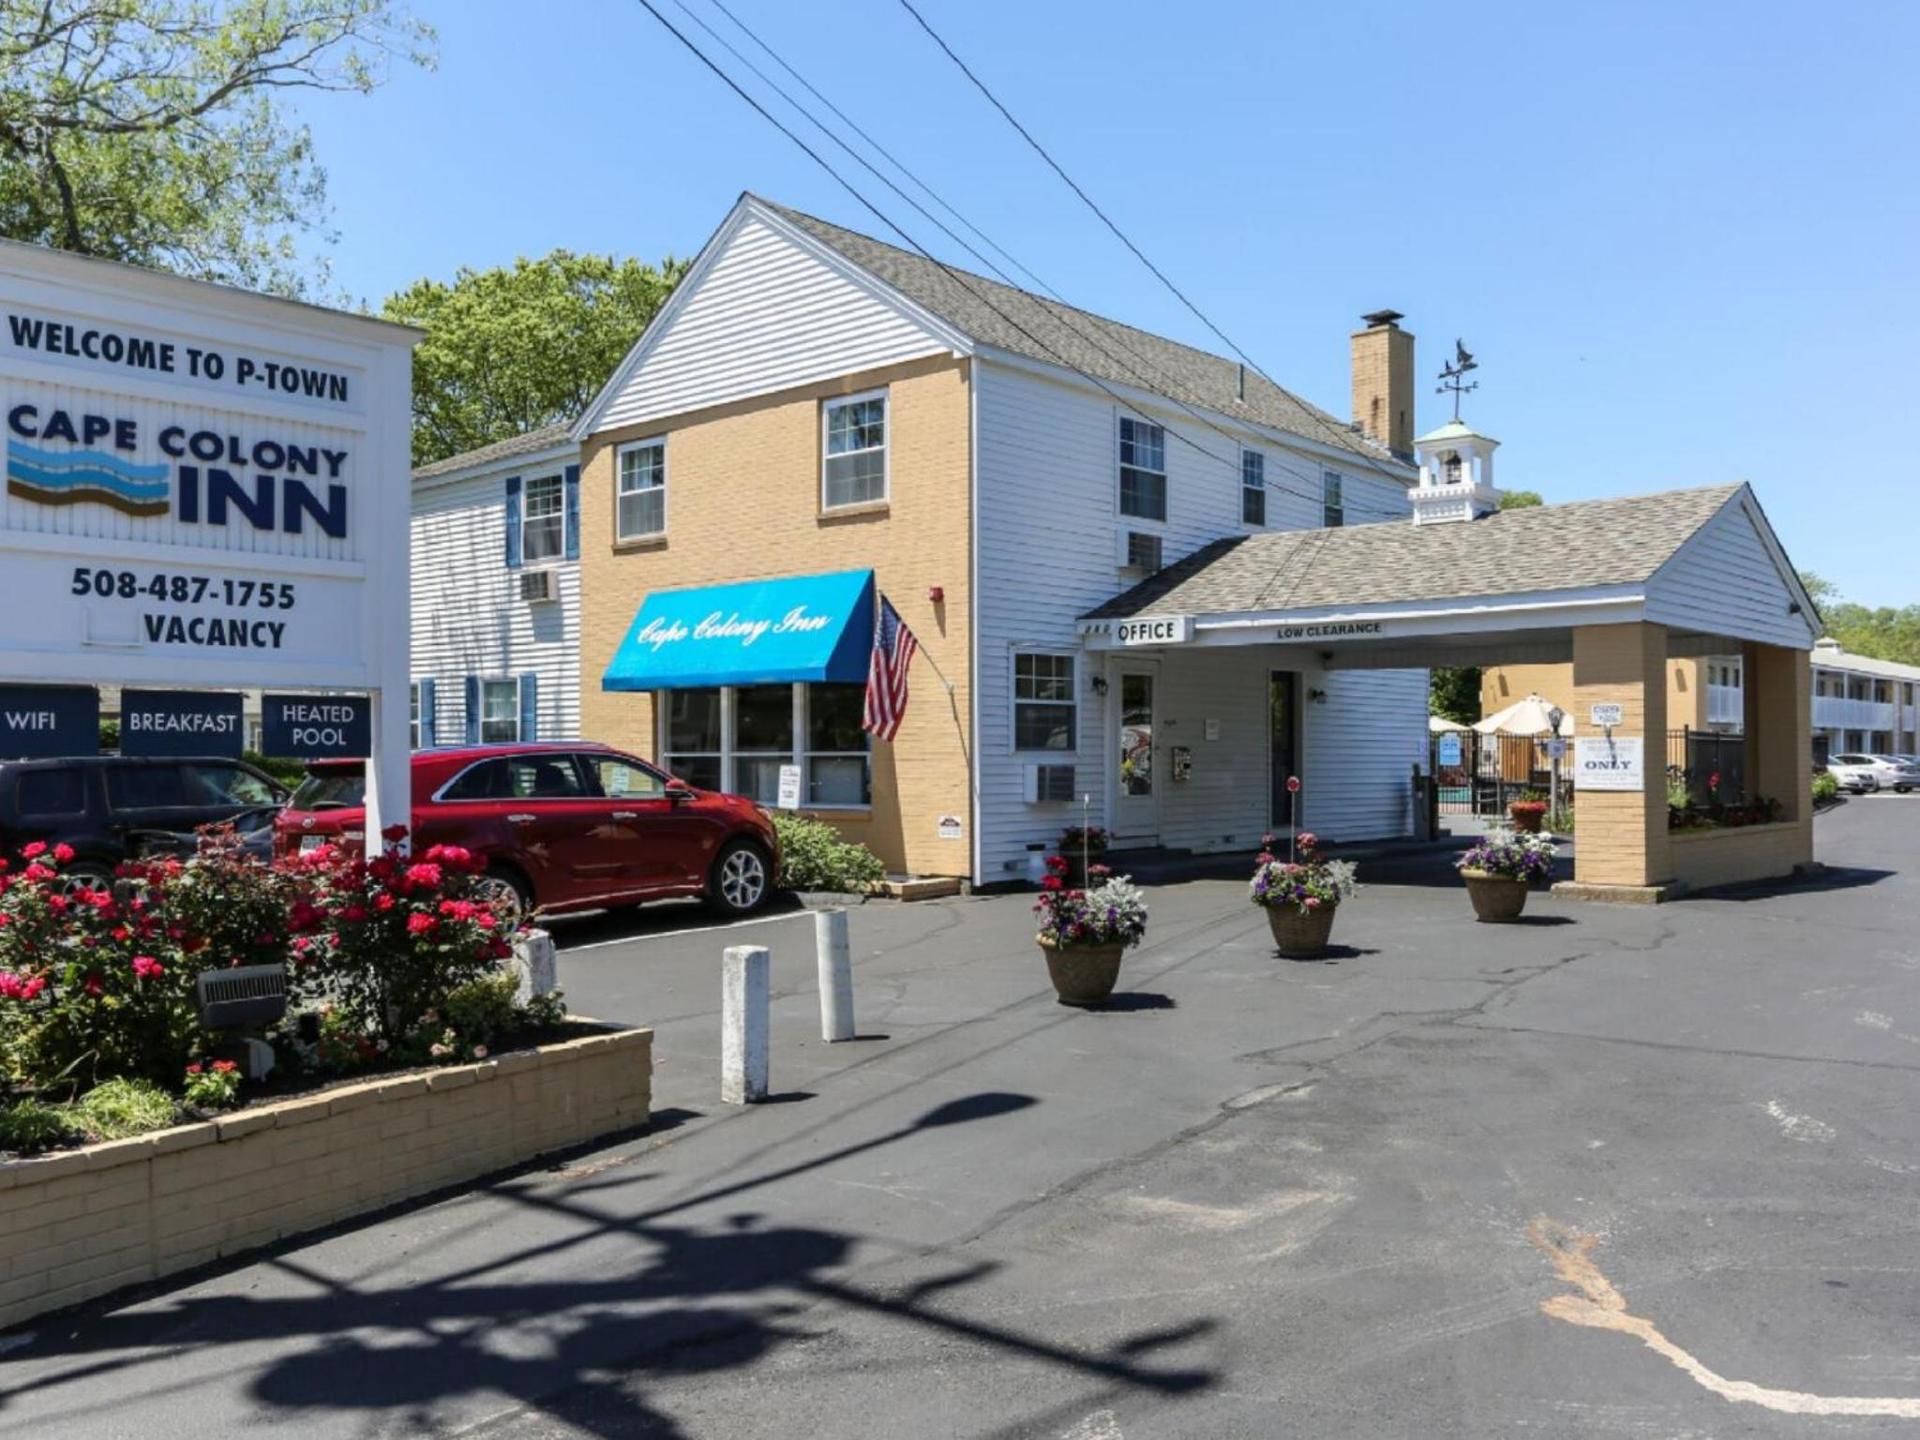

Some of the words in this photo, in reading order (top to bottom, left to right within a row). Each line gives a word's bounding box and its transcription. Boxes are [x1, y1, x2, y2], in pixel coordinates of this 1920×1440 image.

[8, 315, 175, 373] WELCOME
[186, 348, 225, 380] TO
[236, 357, 348, 402] P-TOWN
[8, 404, 137, 451] CAPE
[158, 426, 348, 478] COLONY
[178, 464, 347, 539] INN
[71, 567, 295, 610] 508-487-1755
[144, 614, 286, 649] VACANCY
[638, 616, 688, 652] Cape
[693, 611, 771, 646] Colony
[773, 605, 832, 634] Inn
[1118, 622, 1174, 640] OFFICE
[1277, 628, 1304, 640] LOW
[1306, 621, 1382, 638] CLEARANCE
[6, 711, 56, 732] WIFI
[130, 712, 237, 733] BREAKFAST
[282, 704, 354, 724] HEATED
[292, 728, 347, 747] POOL
[1585, 761, 1631, 769] ONLY
